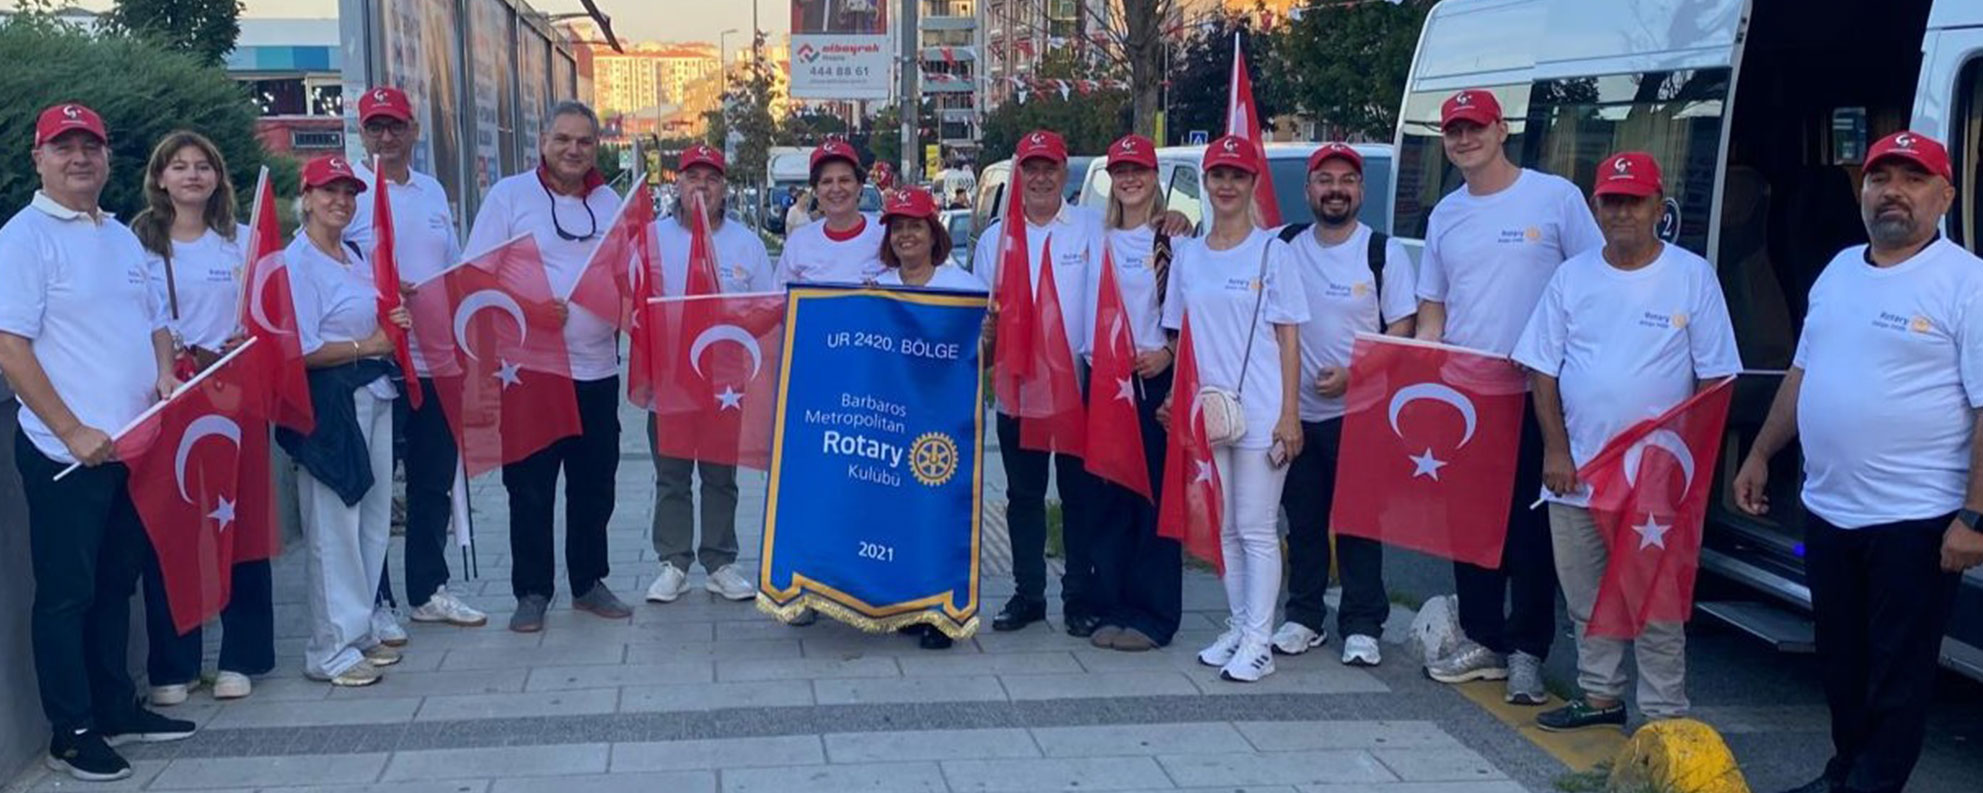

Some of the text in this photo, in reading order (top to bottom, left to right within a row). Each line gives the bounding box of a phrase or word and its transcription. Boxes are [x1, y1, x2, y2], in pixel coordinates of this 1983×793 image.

[809, 66, 869, 77] 444 88 61
[1662, 212, 1673, 236] 2
[827, 332, 960, 360] UR 2420. BÖLGE
[841, 393, 907, 418] Barbaros
[805, 409, 905, 434] Metropolitan
[823, 430, 904, 469] Rotary
[848, 464, 901, 488] Kulübü
[858, 541, 895, 563] 2021
